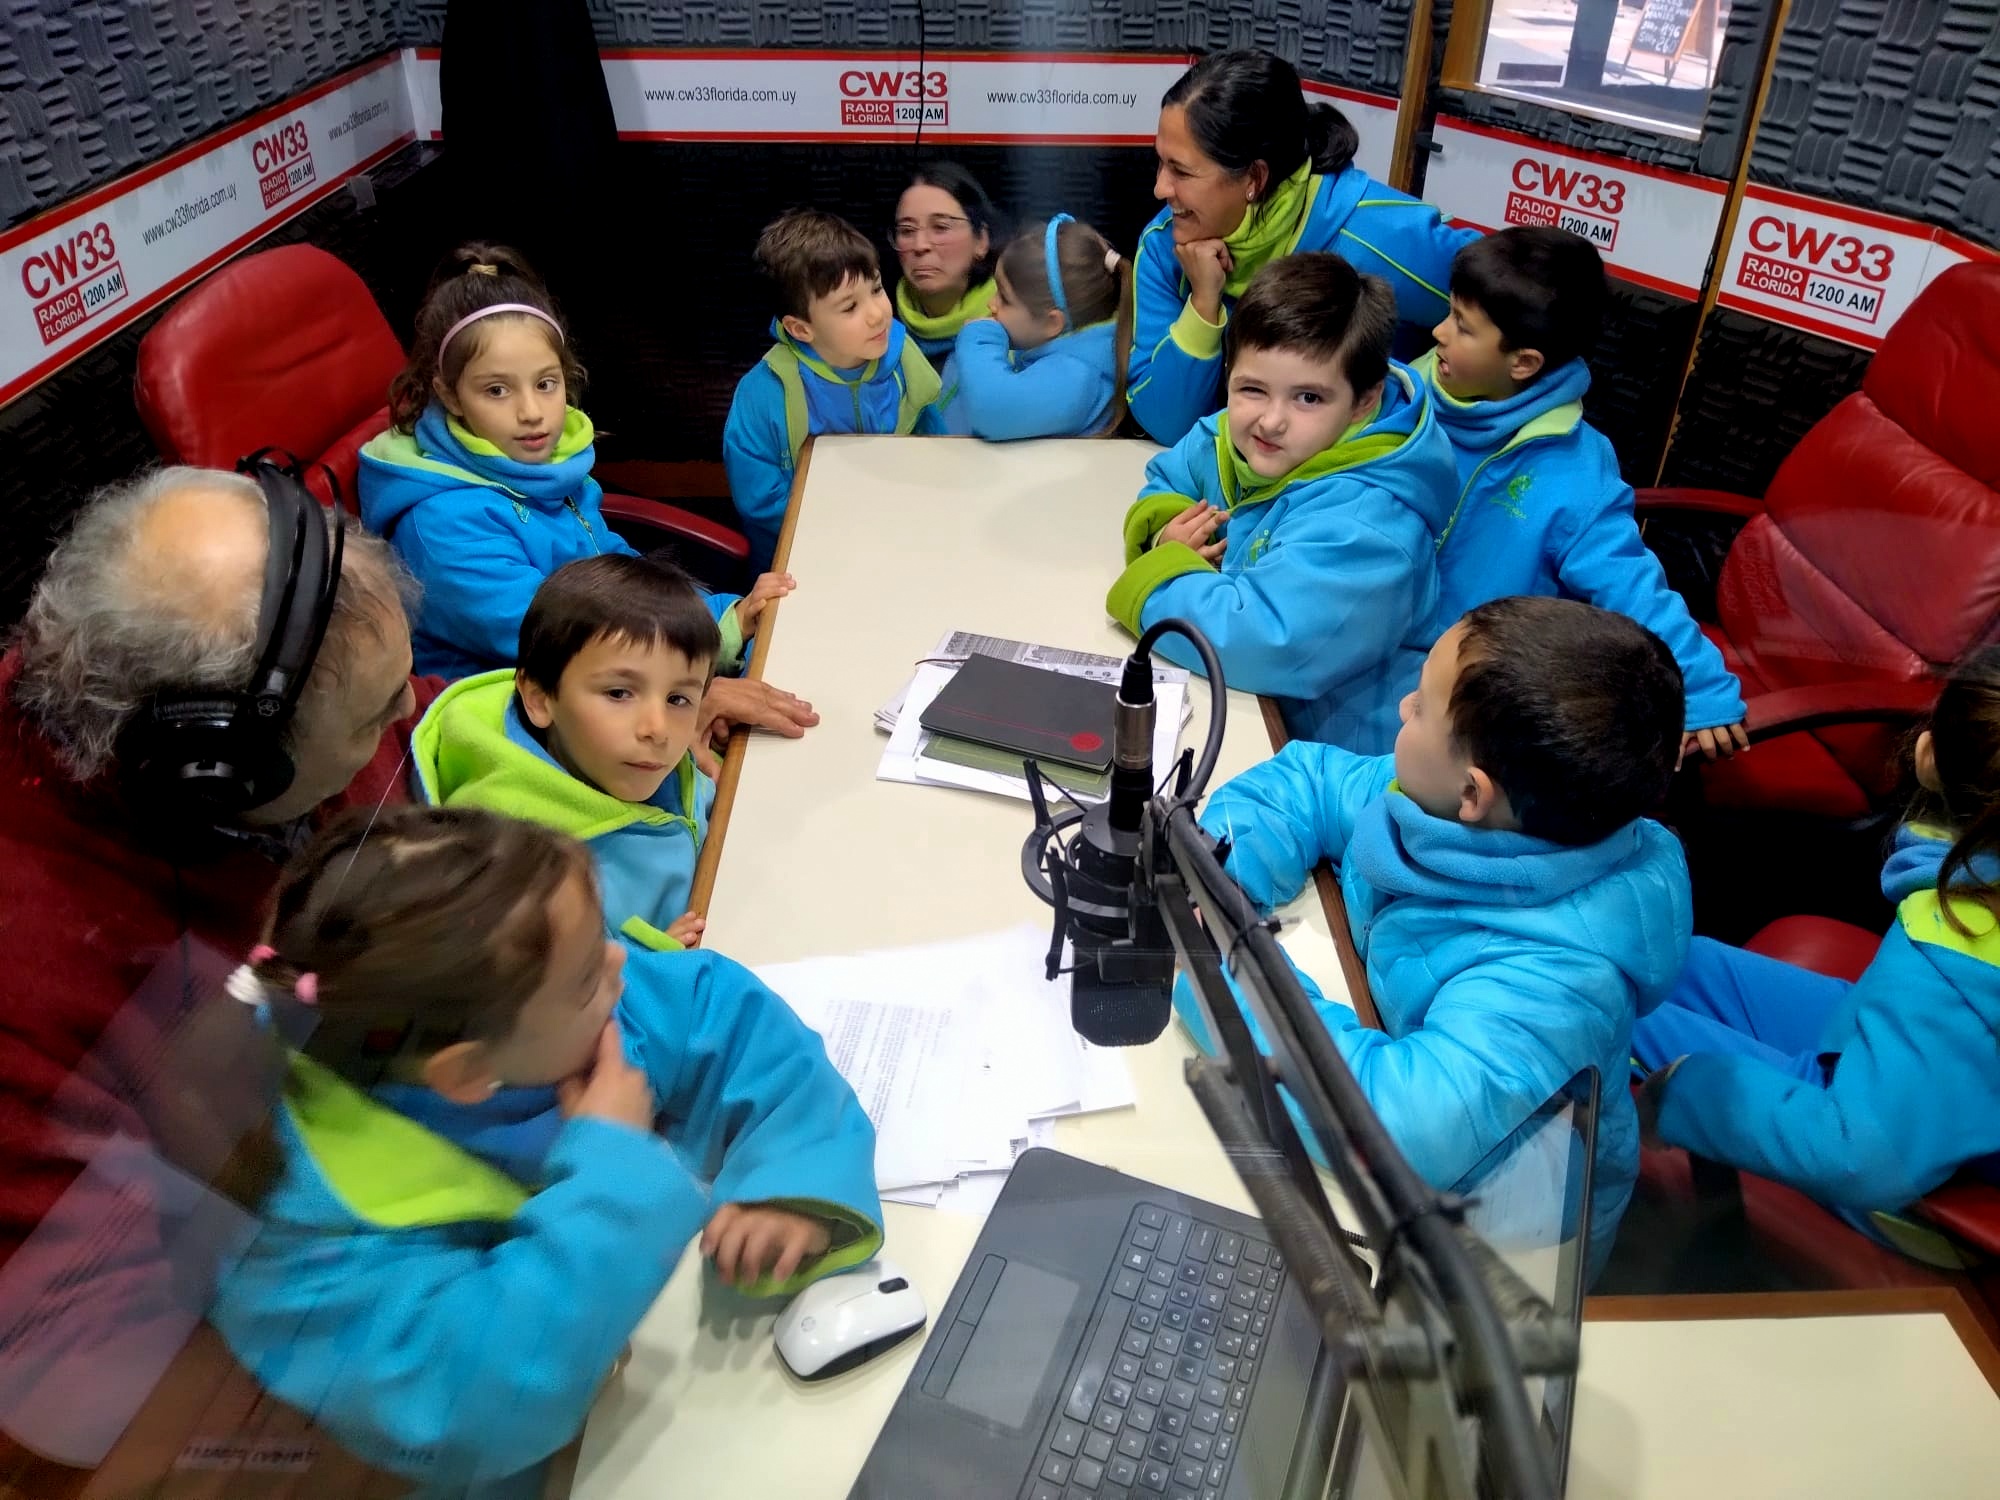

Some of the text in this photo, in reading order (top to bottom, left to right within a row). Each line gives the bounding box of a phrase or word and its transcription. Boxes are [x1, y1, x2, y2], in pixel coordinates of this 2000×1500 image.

[645, 86, 797, 105] www.cw33florida.com.uy
[839, 70, 948, 98] CW33
[845, 103, 890, 113] RADIO
[986, 89, 1137, 108] www.cw33florida.com.uy
[845, 114, 891, 123] FLORIDA
[895, 108, 944, 120] 1200 AM
[252, 120, 308, 174] CW33
[262, 172, 286, 193] RADIO
[288, 161, 313, 187] 1200 AM
[1512, 158, 1626, 214] CW33
[265, 184, 289, 206] FLORIDA
[1511, 197, 1556, 218] RADIO
[142, 182, 238, 246] www.cw33florida.com.uy
[1561, 216, 1612, 243] 1200 AM
[21, 222, 115, 300] CW33
[1748, 215, 1895, 282] CW33
[1746, 258, 1803, 284] RADIO
[82, 273, 123, 309] 1200 AM
[1743, 272, 1800, 299] FLORIDA
[1808, 281, 1876, 314] 1200 AM
[38, 292, 78, 325] RADIO
[43, 309, 85, 340] FLORIDA
